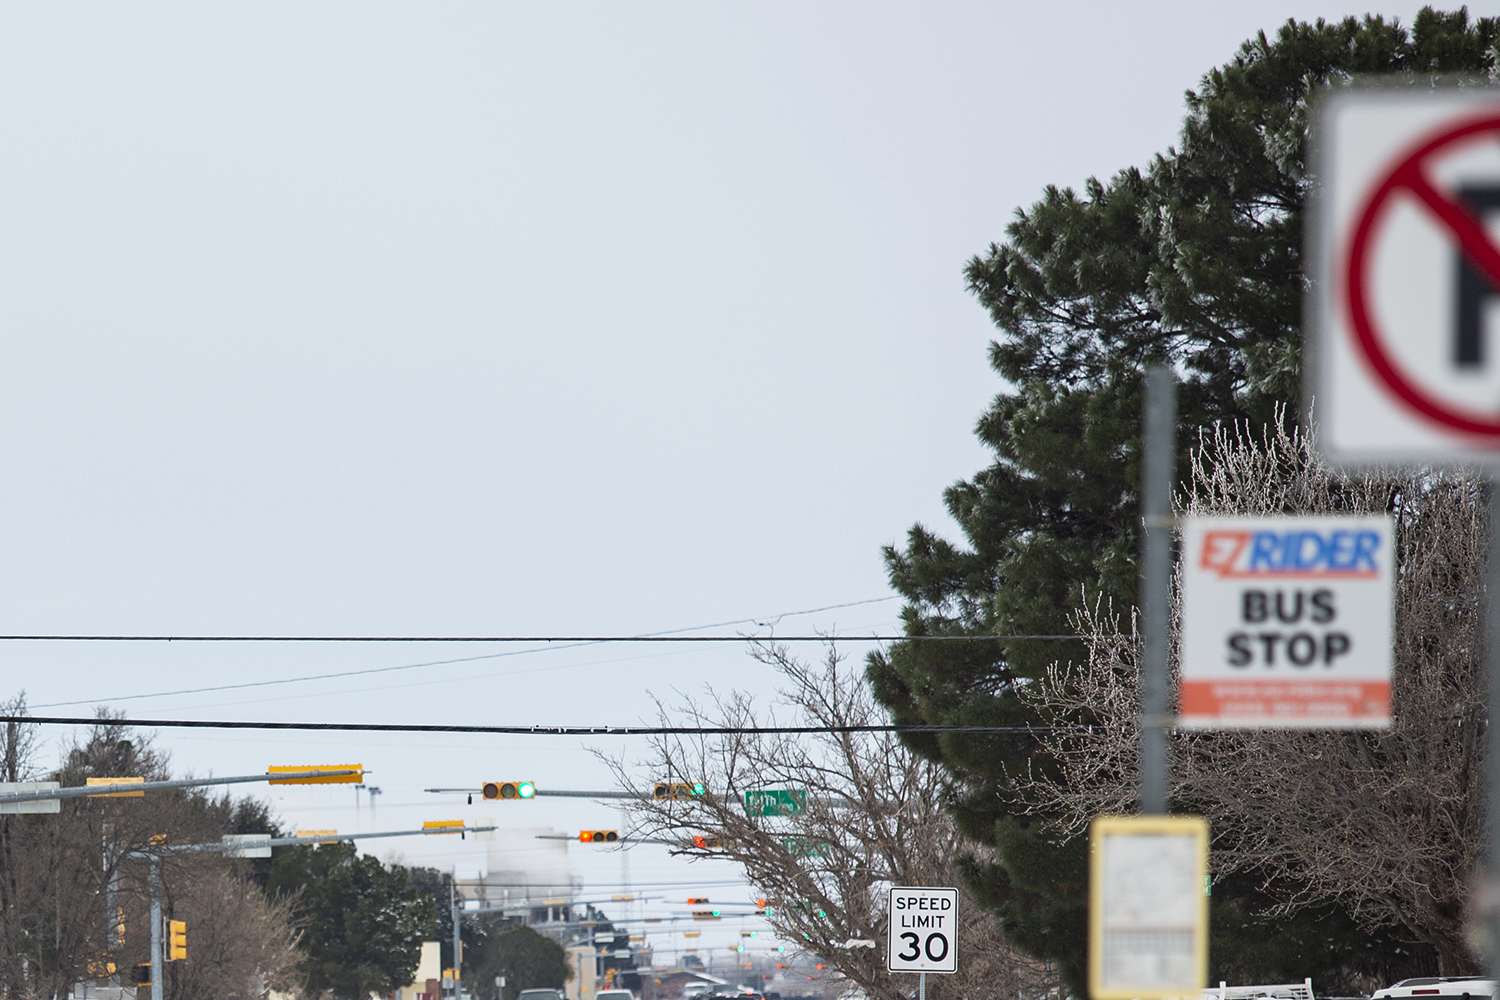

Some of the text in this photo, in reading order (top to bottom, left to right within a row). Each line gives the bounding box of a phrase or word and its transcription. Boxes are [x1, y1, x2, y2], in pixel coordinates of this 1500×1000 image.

[1241, 588, 1336, 625] BUS
[1227, 630, 1352, 668] STOP
[896, 897, 952, 910] SPEED
[901, 915, 945, 928] LIMIT
[897, 931, 949, 962] 30
